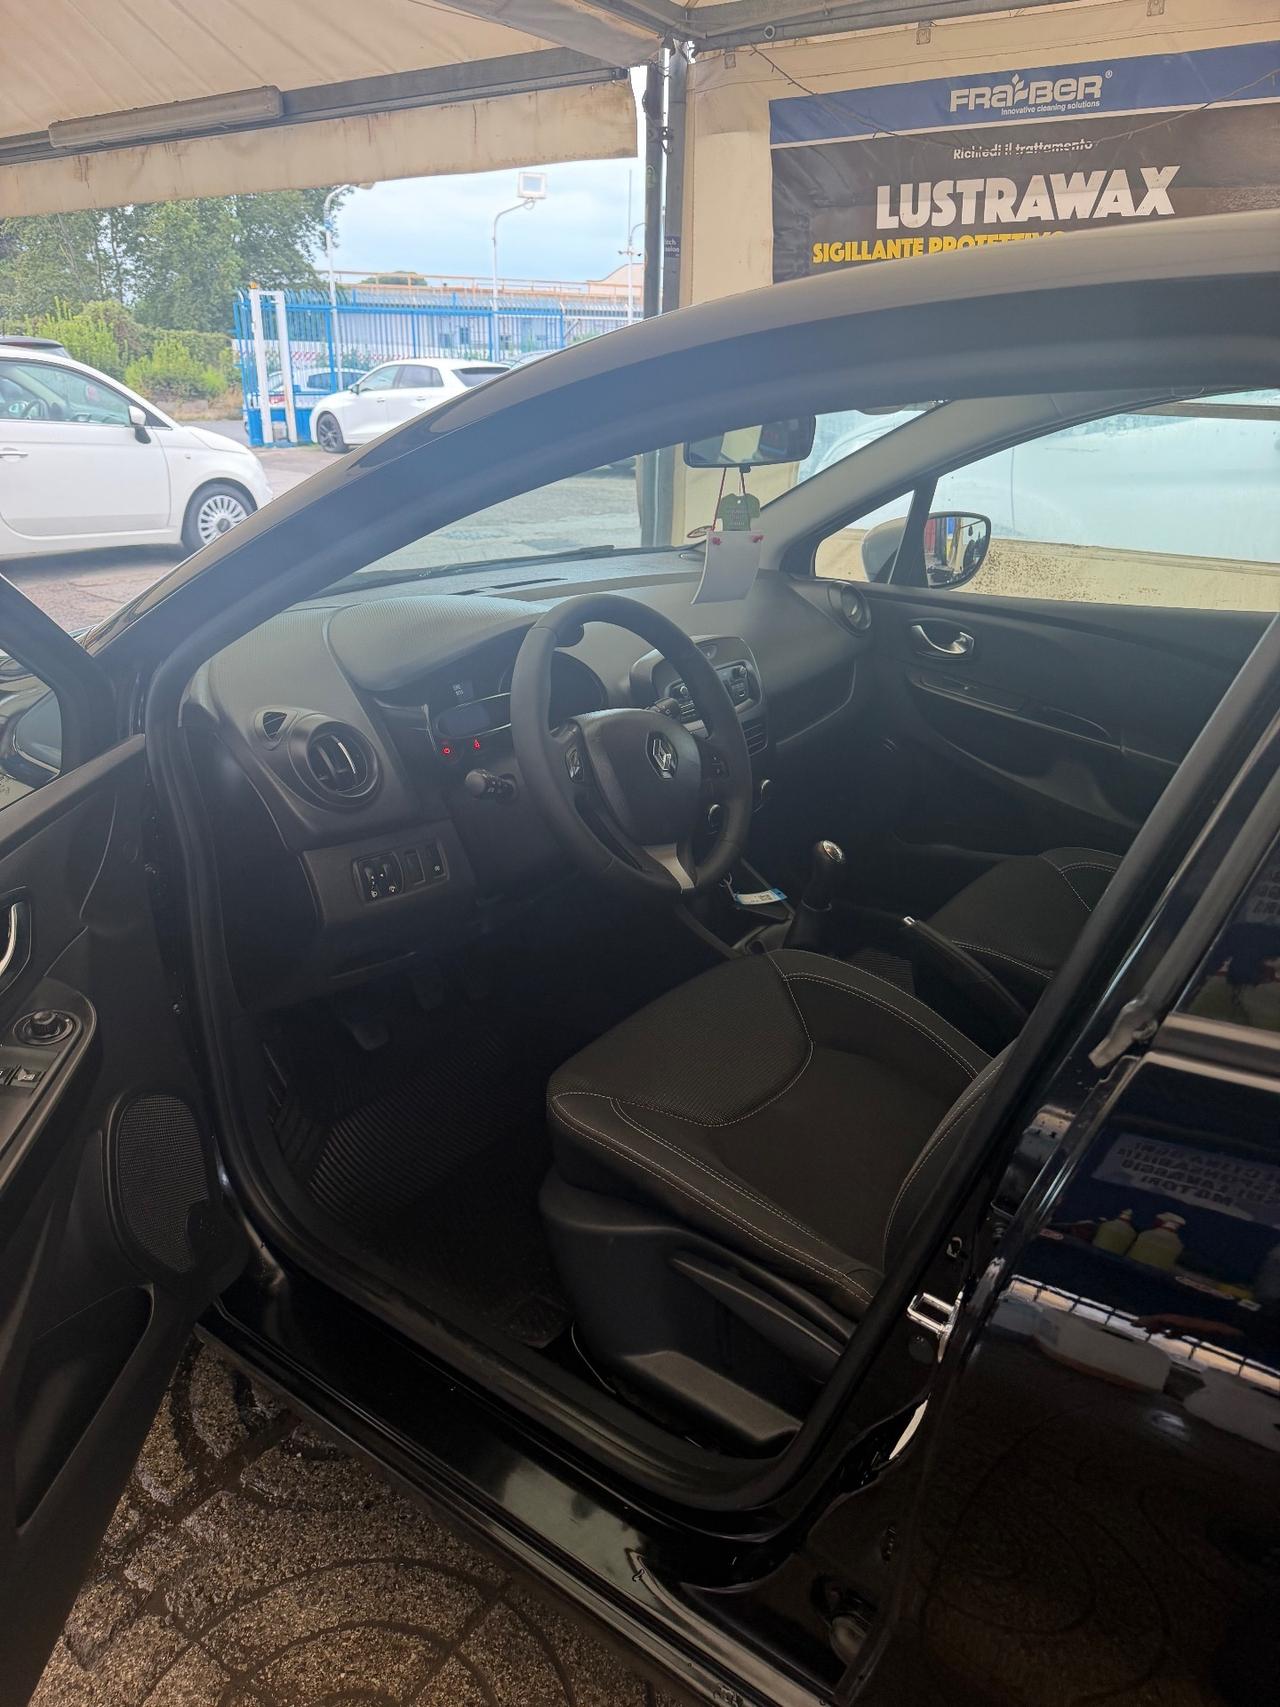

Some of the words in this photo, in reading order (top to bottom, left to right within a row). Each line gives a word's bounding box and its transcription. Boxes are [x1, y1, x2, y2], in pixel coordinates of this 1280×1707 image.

[1036, 102, 1066, 112] cleaning
[1067, 100, 1100, 110] solutions
[876, 165, 1181, 230] LUSTRAWAX
[812, 237, 924, 263] SIGILLANTE
